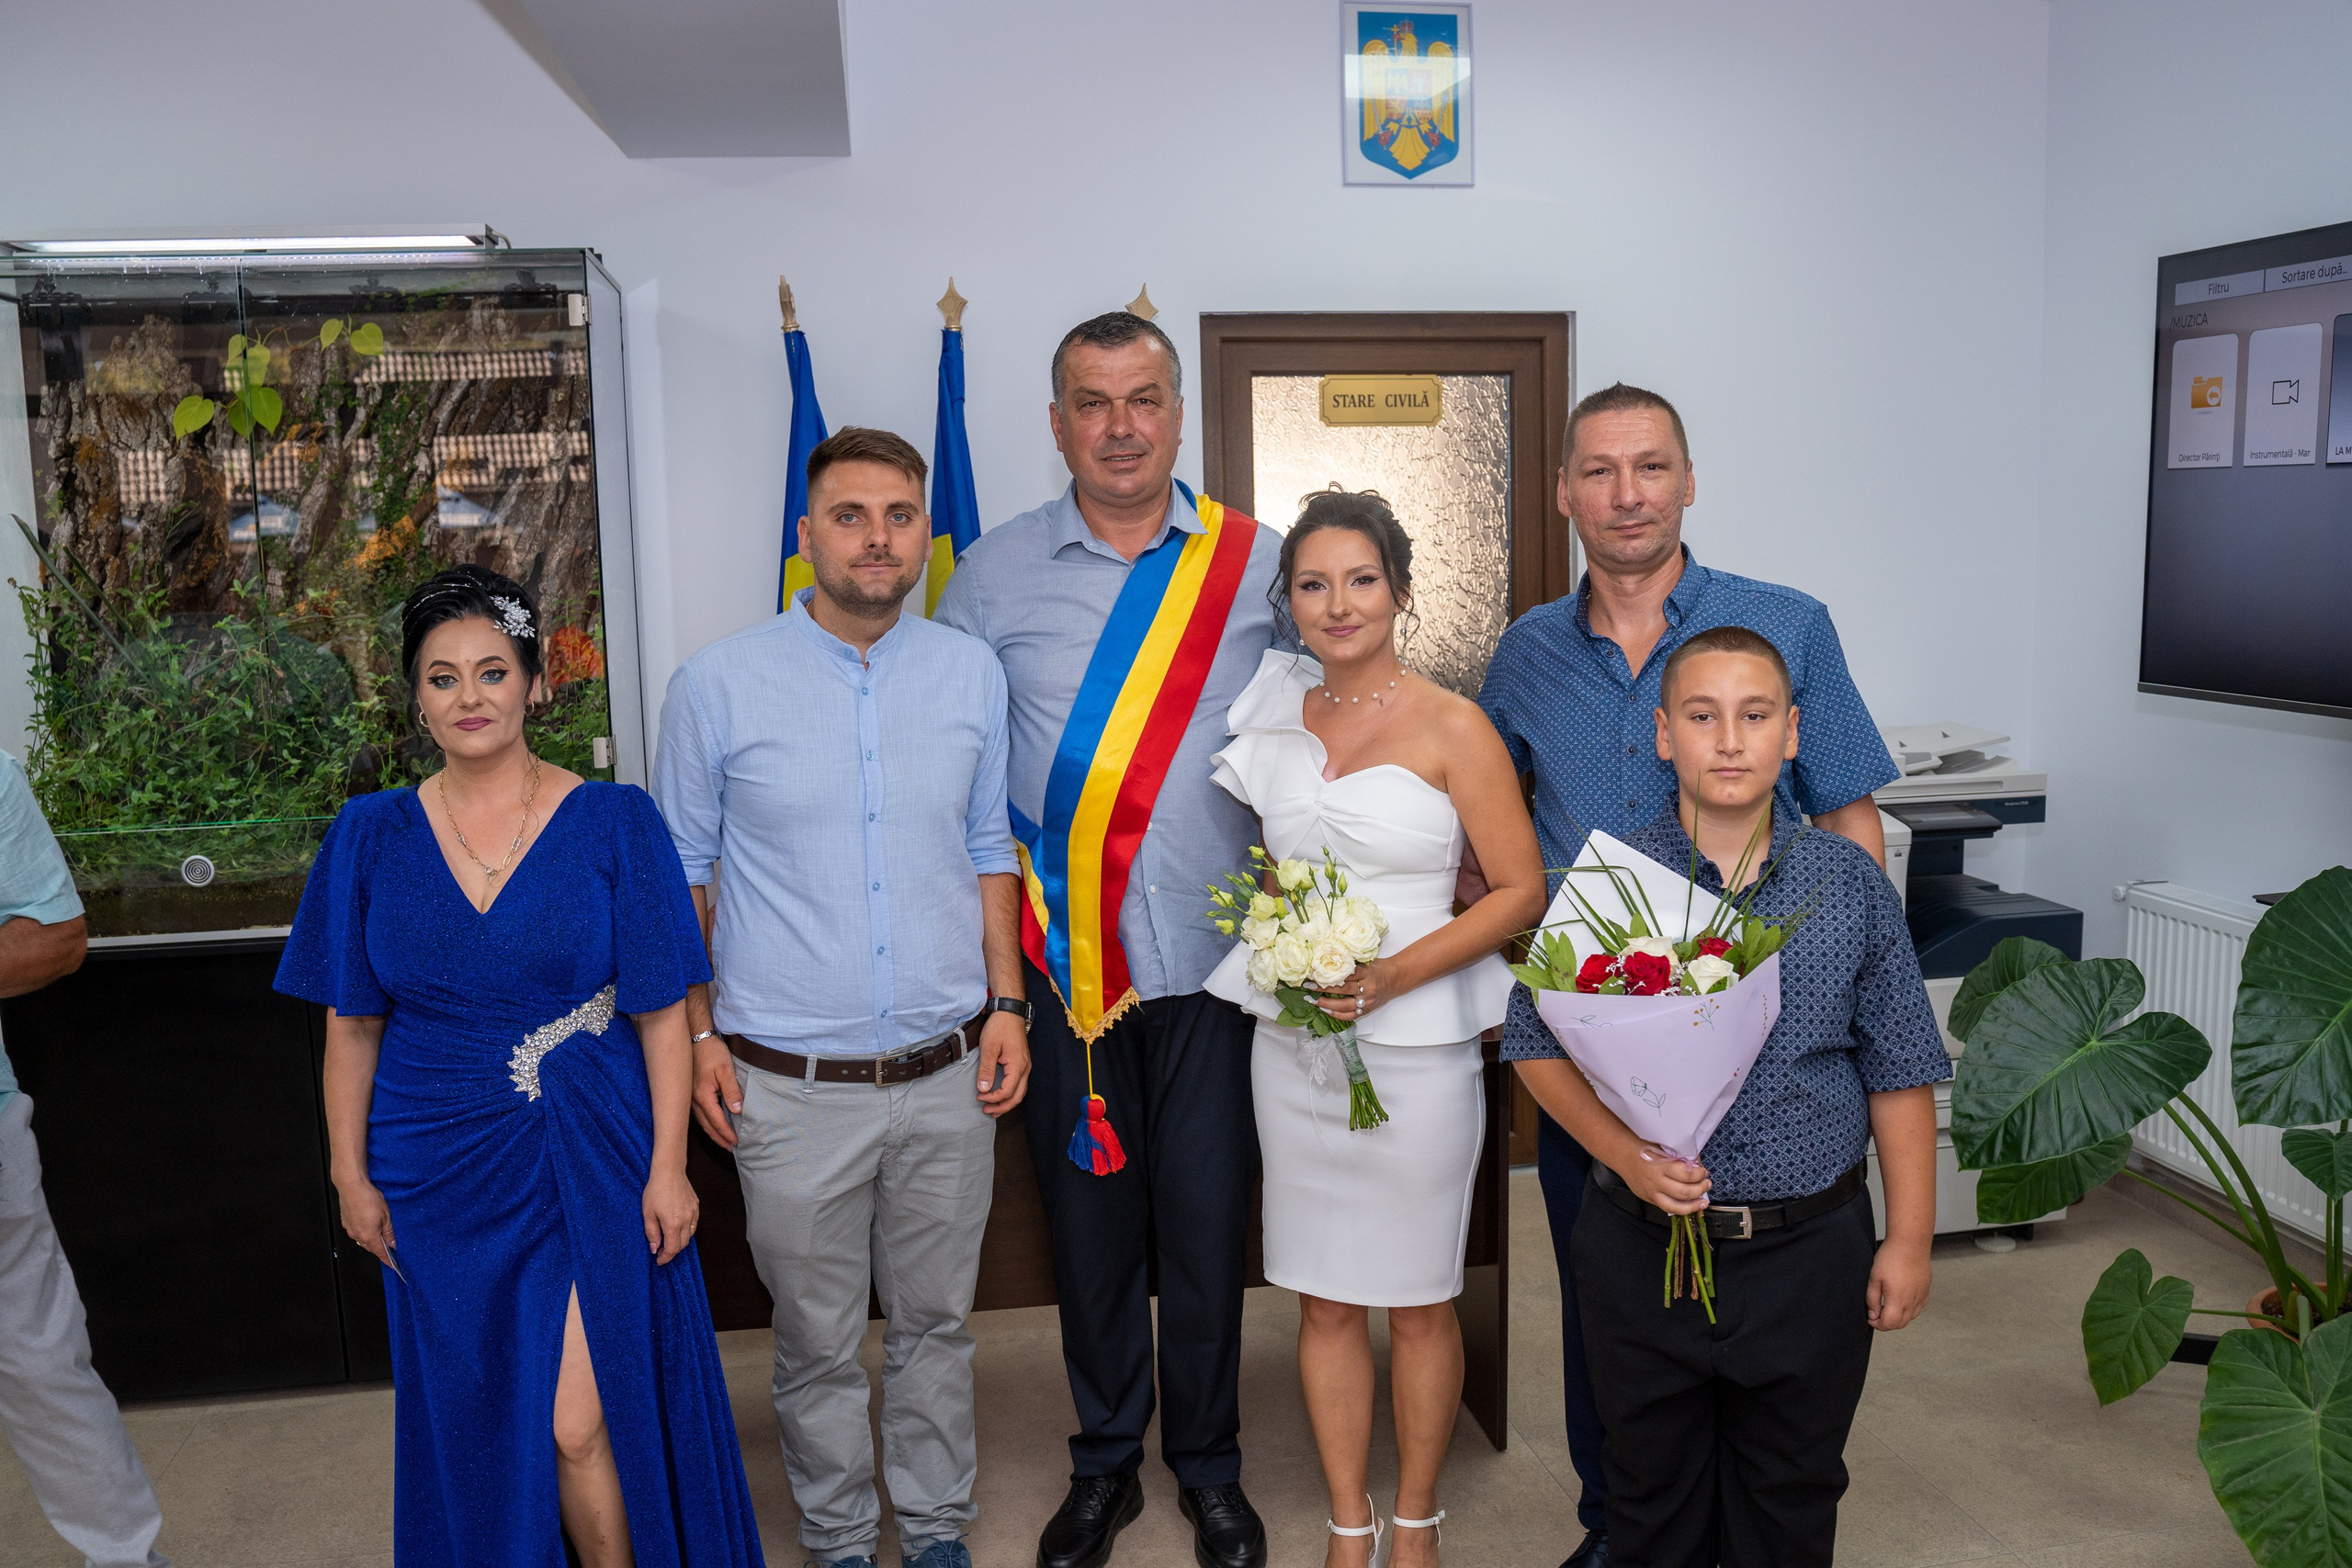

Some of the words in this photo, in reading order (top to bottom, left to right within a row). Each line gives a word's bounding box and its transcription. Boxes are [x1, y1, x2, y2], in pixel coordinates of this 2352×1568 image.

[2281, 269, 2315, 284] Sortare
[2208, 282, 2230, 295] Filtru
[1332, 394, 1375, 408] STARE
[1385, 390, 1430, 408] CIVILĂ
[2335, 446, 2344, 456] LA
[2178, 454, 2201, 462] Director
